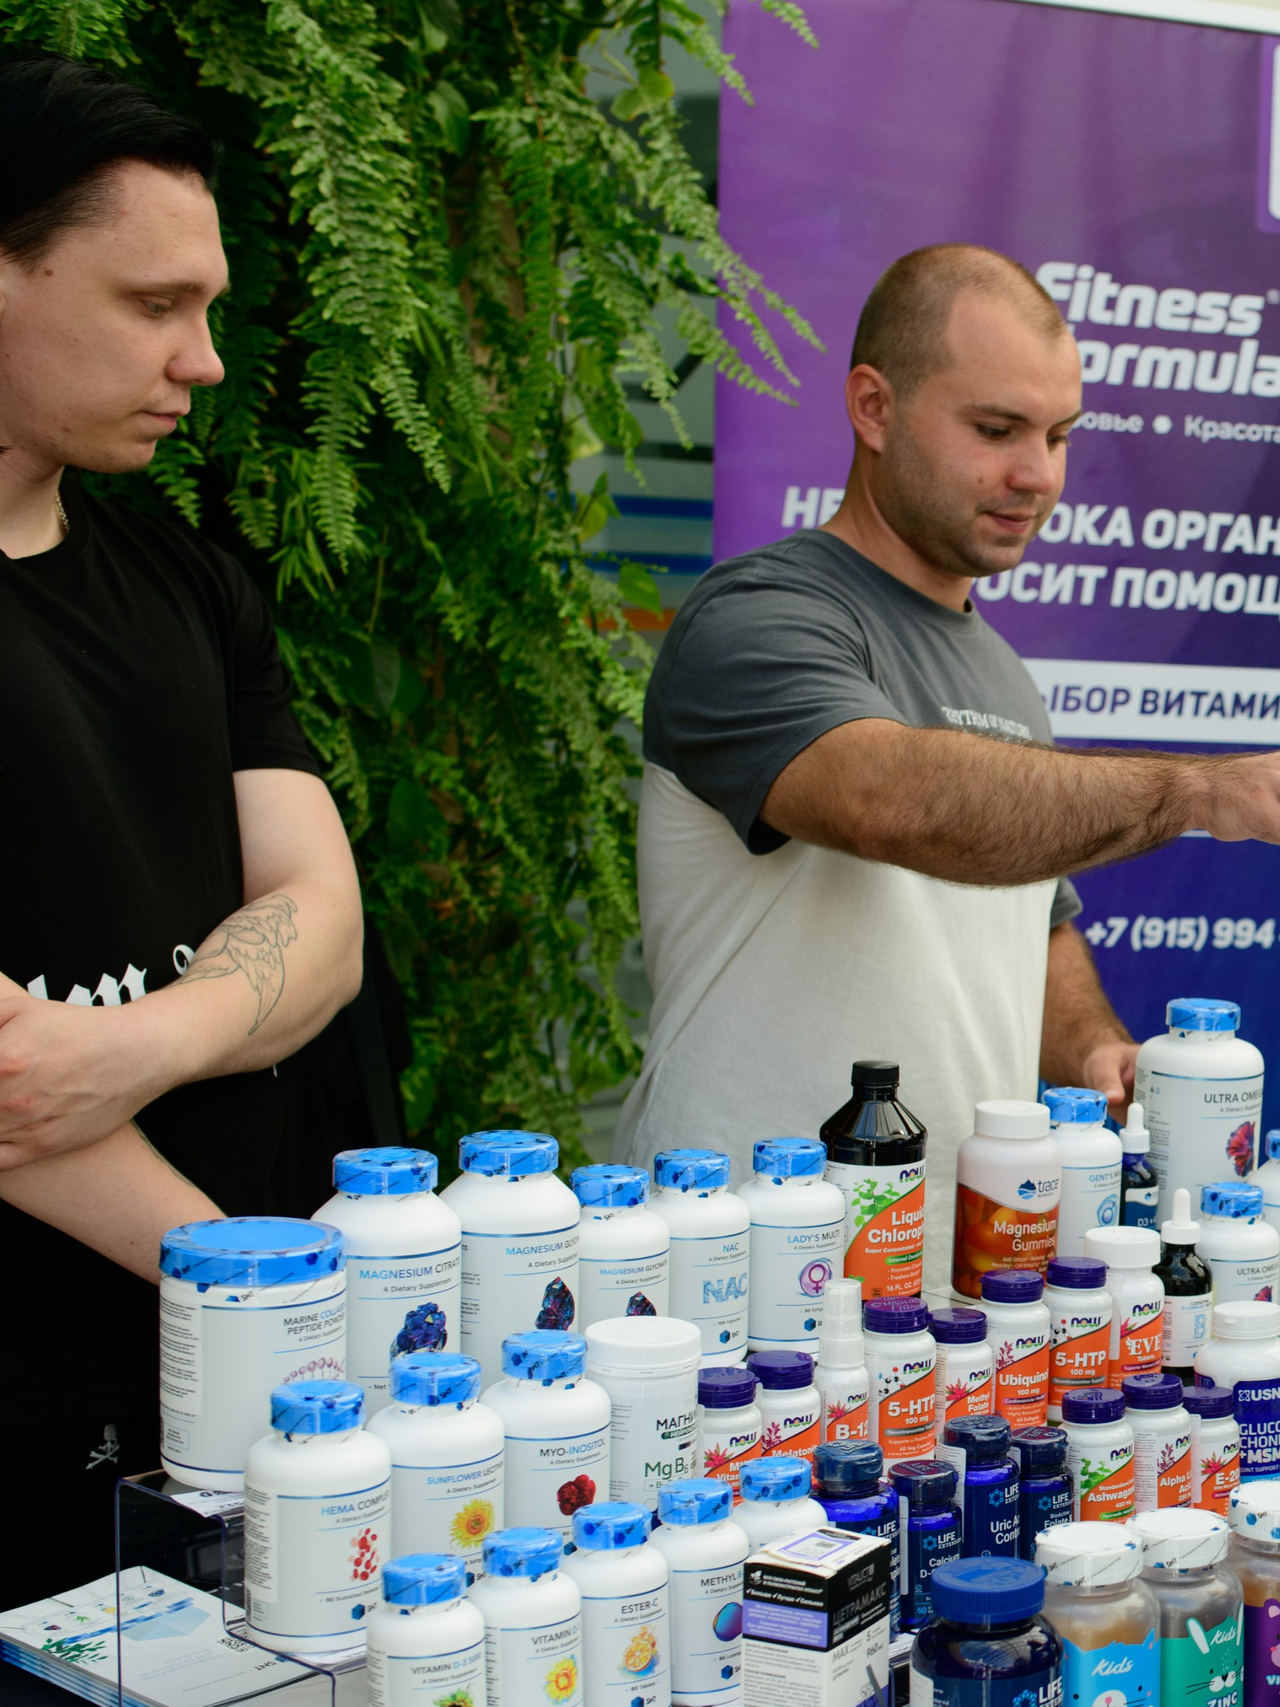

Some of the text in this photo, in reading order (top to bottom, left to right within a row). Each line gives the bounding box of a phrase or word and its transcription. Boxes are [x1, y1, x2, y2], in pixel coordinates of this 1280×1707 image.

[1070, 411, 1144, 434] овье
[1033, 503, 1135, 548] ОКА
[972, 560, 1108, 605] ОСИТ
[1085, 916, 1129, 949] +7
[1131, 914, 1209, 953] (915)
[1212, 920, 1276, 950] 994
[1204, 1093, 1239, 1104] ULTRA
[1088, 1171, 1114, 1183] GENT'S
[867, 1224, 925, 1244] Chlorop
[993, 1219, 1057, 1238] Magnesium
[787, 1229, 841, 1245] LADY'S MULTI
[1012, 1235, 1056, 1252] Gummies
[505, 1242, 564, 1257] MAGNESIUM
[722, 1242, 740, 1253] NAC
[358, 1256, 462, 1281] MAGNESIUM CITRATE
[534, 1257, 557, 1270] Dietary
[599, 1266, 645, 1276] MAGNESIUM
[1236, 1267, 1261, 1276] ULTRA
[390, 1276, 453, 1295] Dietary Supplement
[702, 1273, 748, 1304] NAC
[1132, 1300, 1162, 1318] now
[283, 1312, 319, 1326] MARINE
[1070, 1316, 1102, 1329] now
[287, 1321, 324, 1336] PEPTIDE
[1015, 1334, 1045, 1350] now
[1054, 1350, 1106, 1369] 5-HTP
[903, 1360, 933, 1376] now
[969, 1366, 991, 1384] now
[1069, 1368, 1083, 1376] 100
[1017, 1388, 1030, 1396] 100
[783, 1413, 814, 1429] now
[905, 1416, 919, 1425] 100
[539, 1438, 606, 1458] MYO-INOSITOL
[729, 1432, 757, 1448] now
[555, 1455, 576, 1467] Dietary
[1110, 1445, 1133, 1462] now
[426, 1470, 482, 1486] SUNFLOWER
[1159, 1473, 1186, 1488] Alpha
[452, 1484, 472, 1495] Dietary
[1052, 1492, 1070, 1505] LIFE
[321, 1503, 356, 1517] HEMA
[341, 1513, 363, 1525] Dietary
[990, 1519, 1013, 1534] Uric
[877, 1519, 897, 1537] LIFE
[937, 1530, 956, 1544] LIFE
[928, 1553, 960, 1568] Calcium
[700, 1574, 738, 1589] METHYL
[709, 1586, 729, 1596] Dietary
[621, 1598, 659, 1615] ESTER-C
[832, 1581, 887, 1627] ЦЕТРАМАКС
[531, 1630, 572, 1646] VITAMIN
[1209, 1625, 1238, 1647] Kids
[411, 1662, 452, 1676] VITAMIN
[1092, 1656, 1134, 1677] Kids
[1039, 1675, 1063, 1704] LIFE
